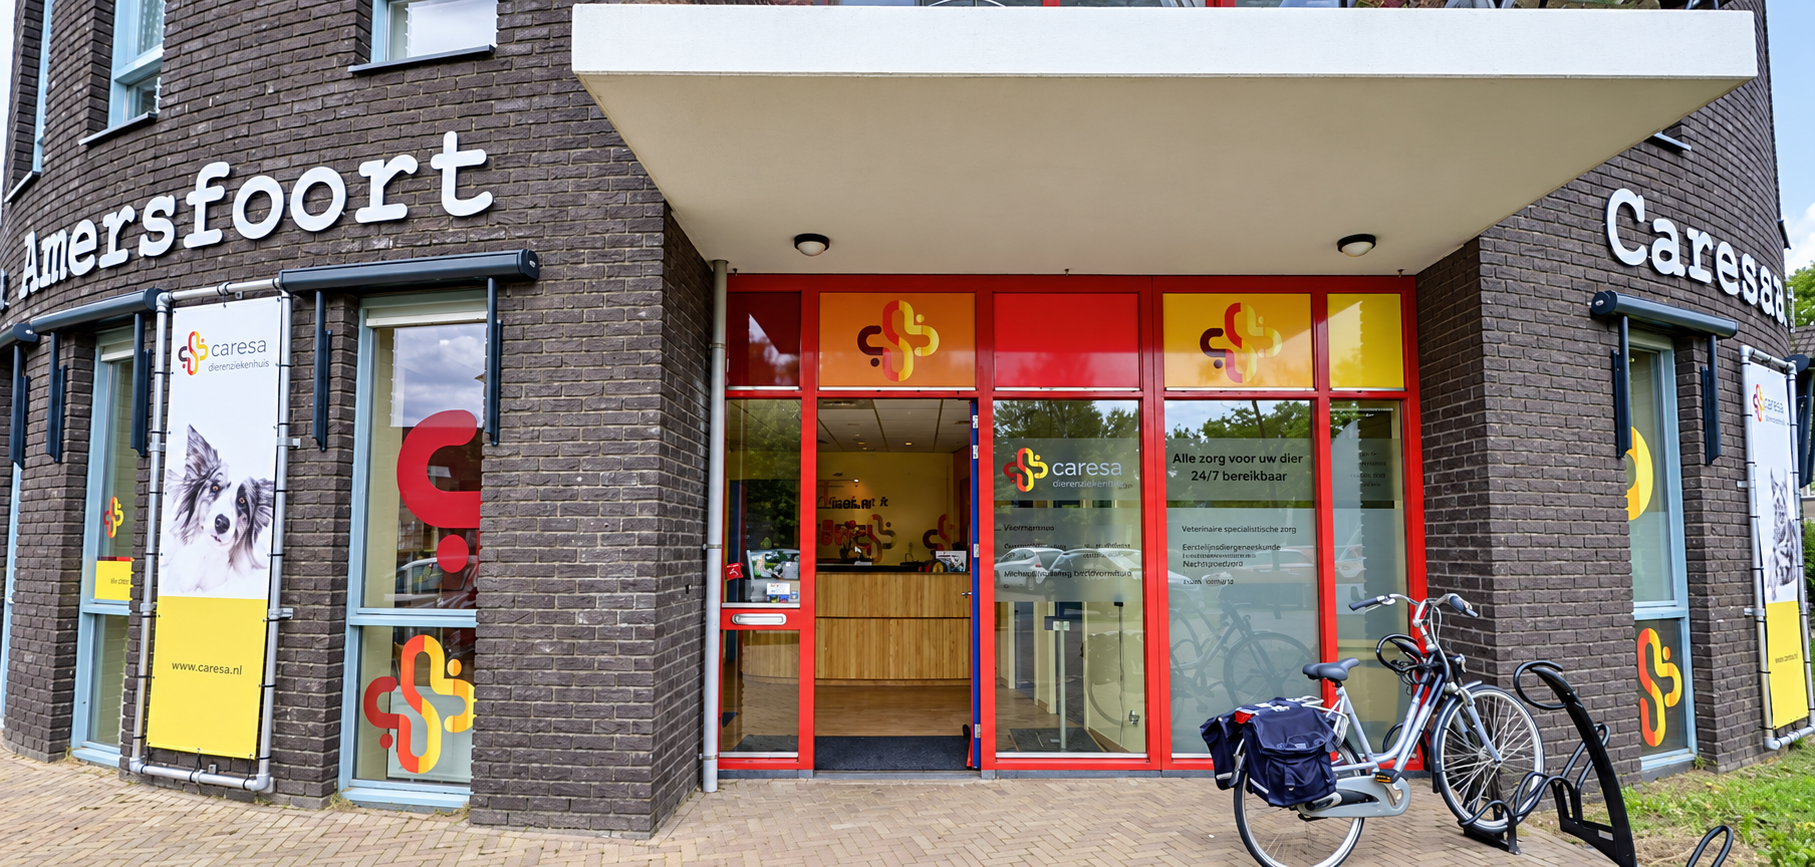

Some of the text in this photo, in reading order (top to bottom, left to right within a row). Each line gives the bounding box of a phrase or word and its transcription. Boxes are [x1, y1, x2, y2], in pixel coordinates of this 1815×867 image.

[18, 131, 494, 299] Amersfoort
[211, 339, 267, 357] caresa
[208, 358, 270, 372] dierenziekenhuis
[1172, 453, 1303, 466] Alle zorg voor uw dier
[1052, 462, 1122, 476] caresa
[1191, 470, 1287, 482] 24/7 bereikbaar
[1181, 525, 1223, 533] Veterinaire
[1280, 526, 1297, 535] zorg
[171, 661, 243, 676] www.caresa.nl
